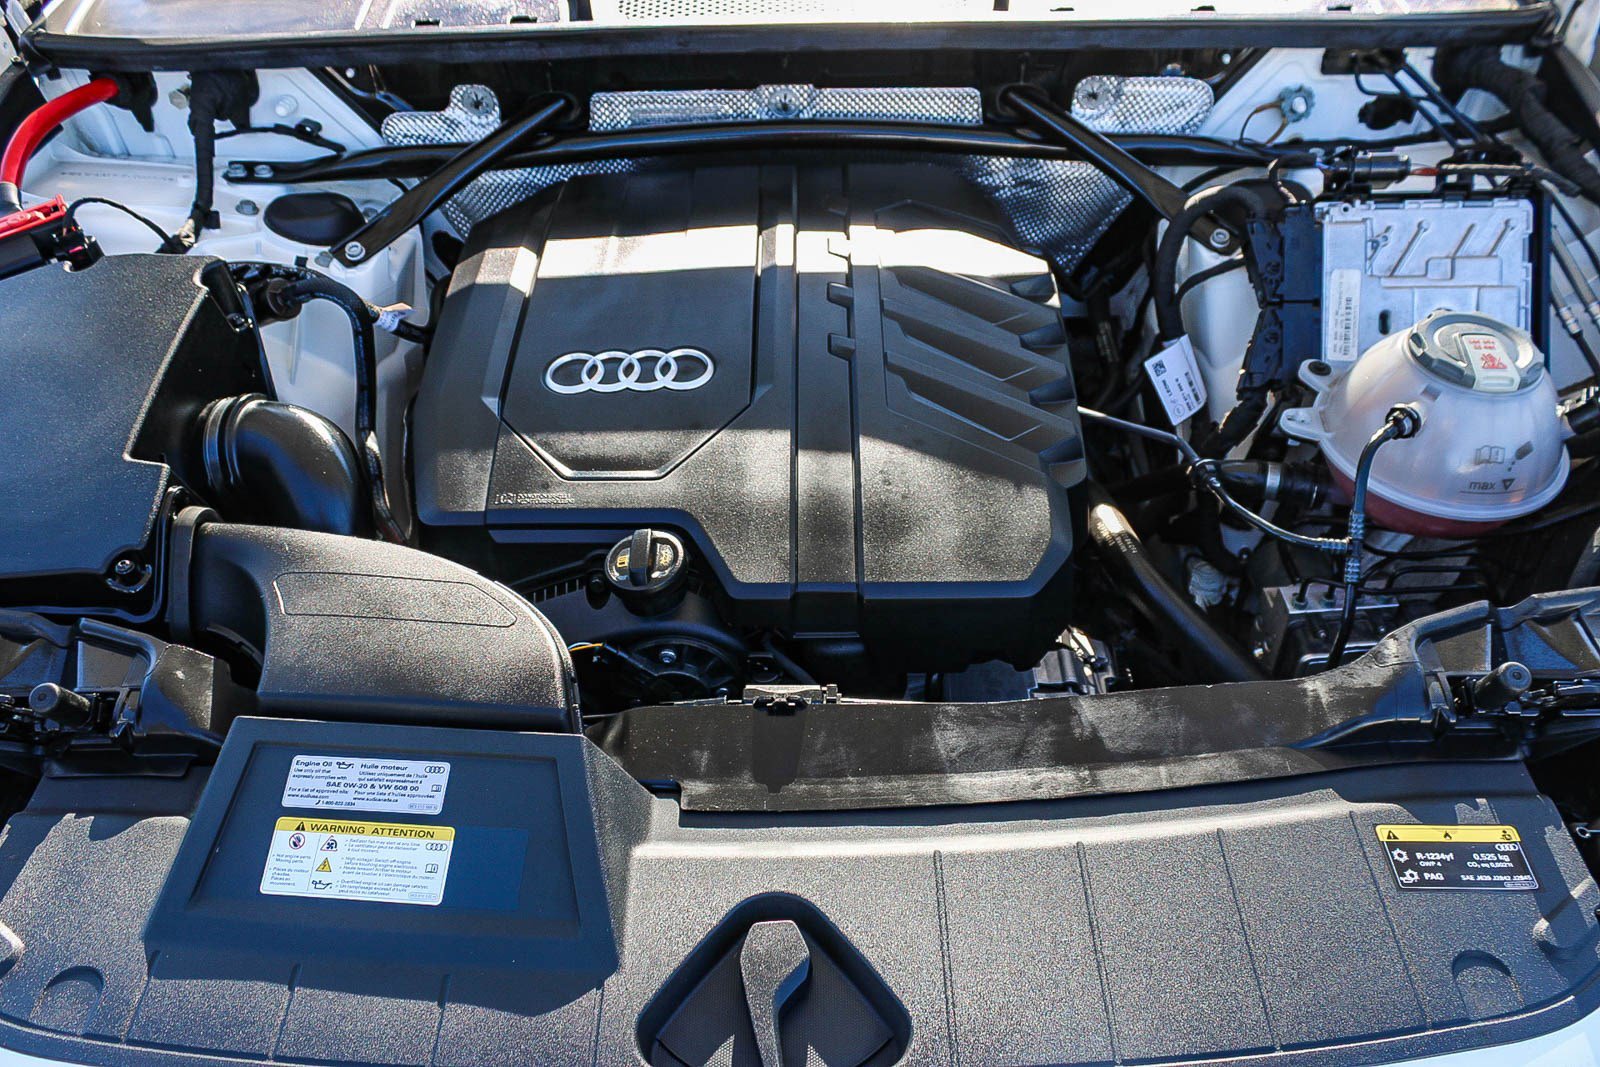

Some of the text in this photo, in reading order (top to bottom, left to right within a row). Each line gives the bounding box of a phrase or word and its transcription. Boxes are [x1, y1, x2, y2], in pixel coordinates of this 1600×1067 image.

[1469, 481, 1496, 490] max
[310, 823, 435, 839] WARNING ATTENTION
[1415, 852, 1455, 861] R-1234yf
[1497, 854, 1511, 862] kg
[1423, 872, 1444, 880] PAG
